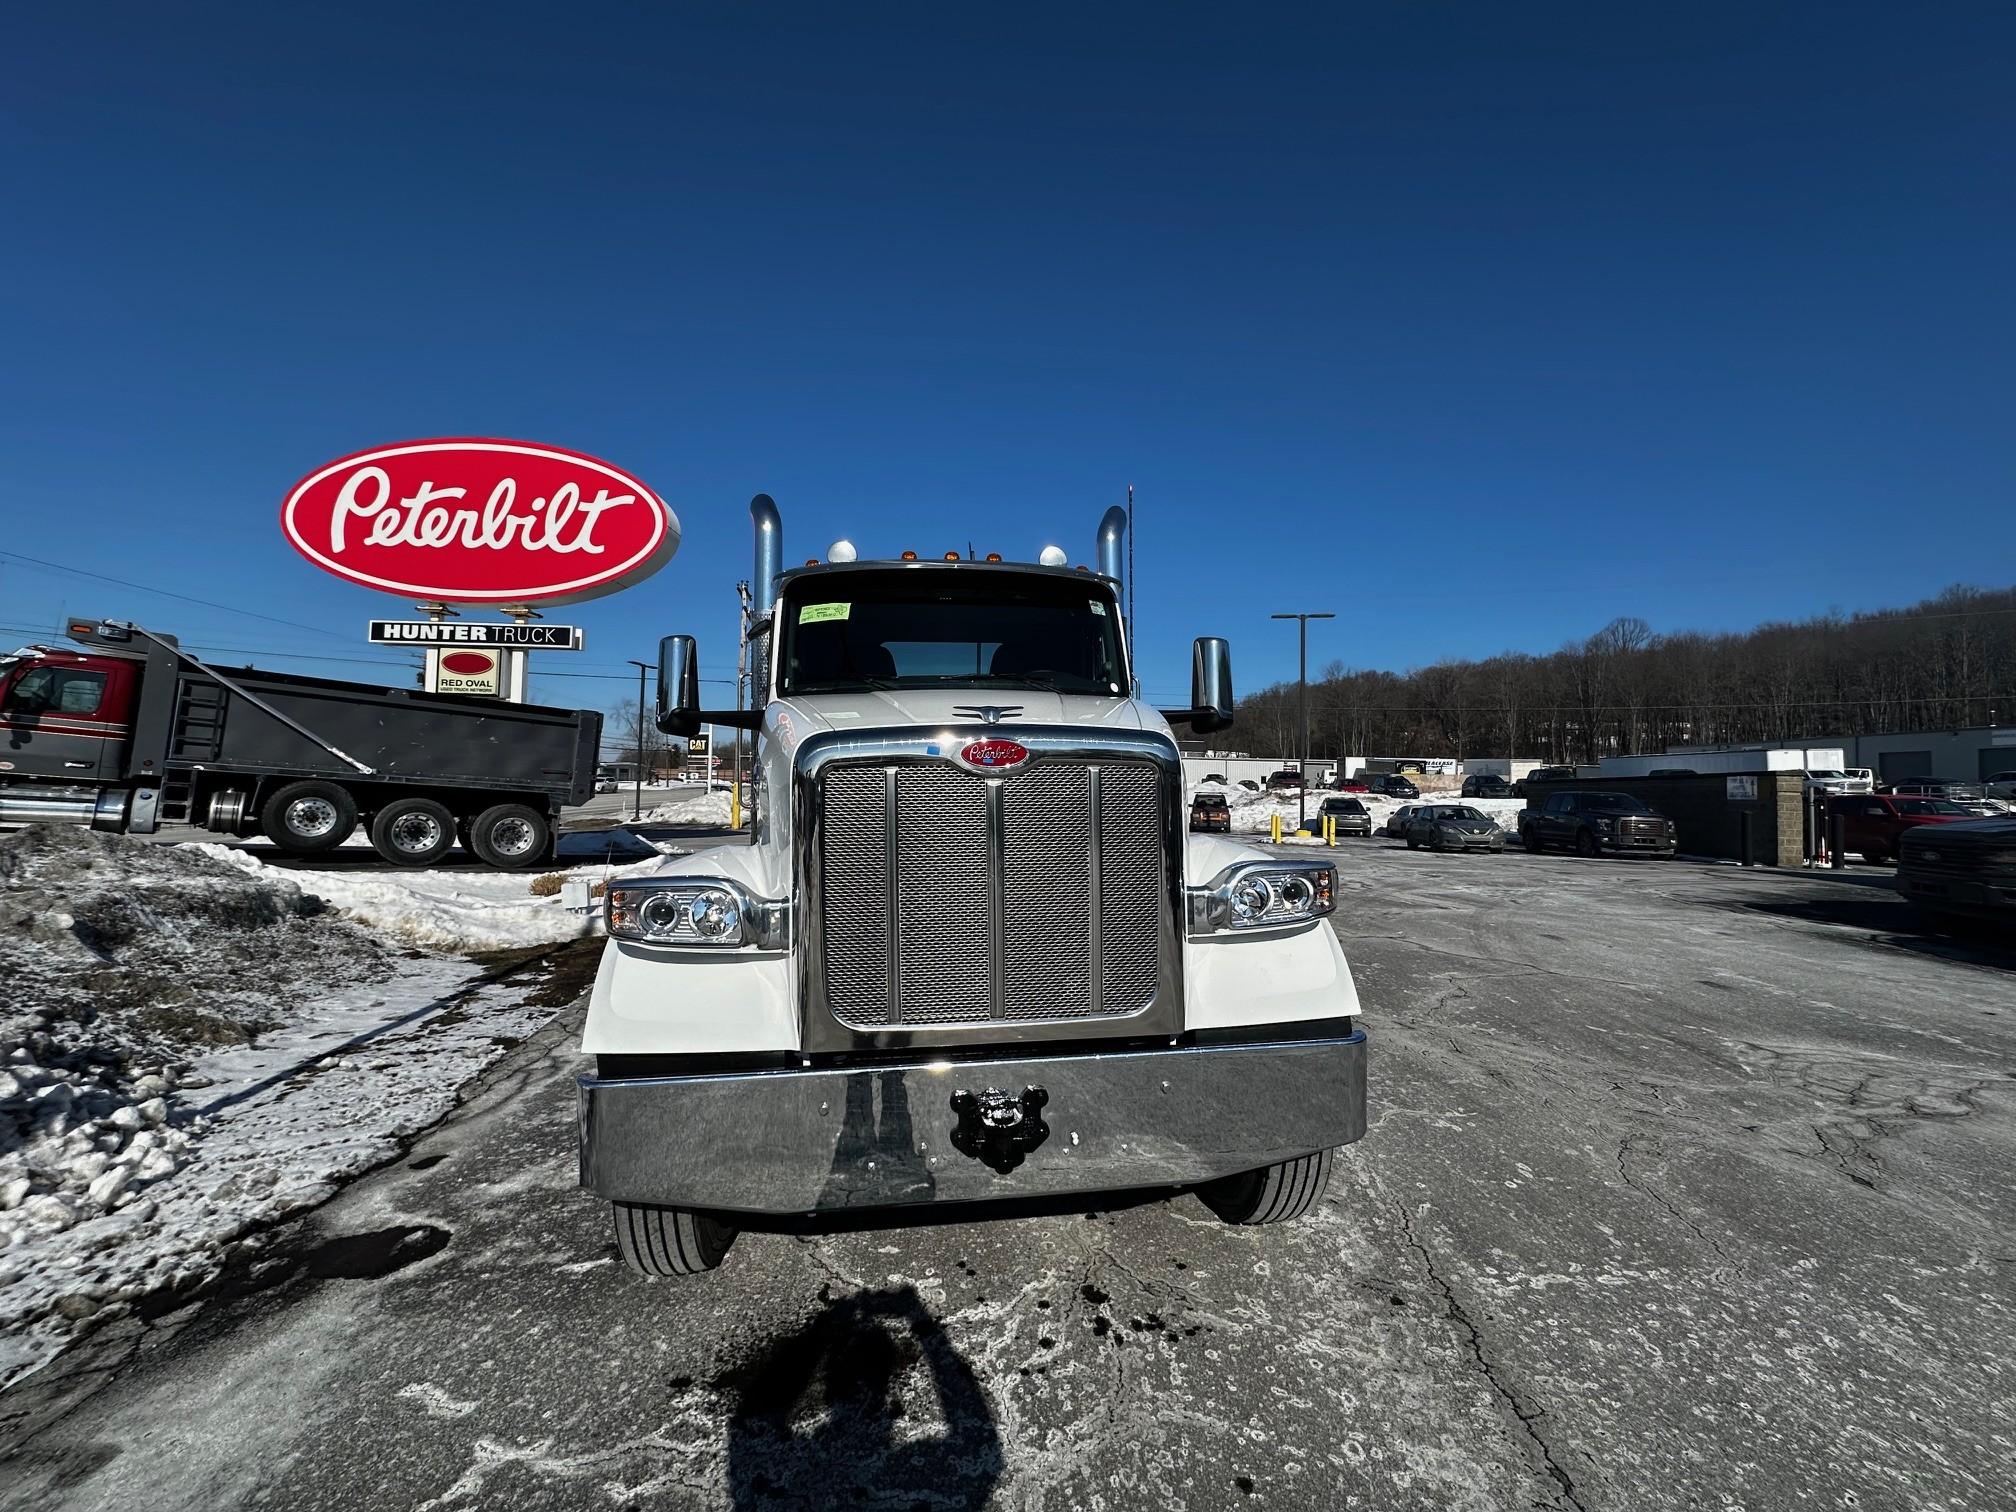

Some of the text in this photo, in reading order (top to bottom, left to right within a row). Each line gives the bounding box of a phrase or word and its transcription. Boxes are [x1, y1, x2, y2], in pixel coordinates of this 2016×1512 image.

[331, 466, 635, 553] Peterbilt
[383, 624, 556, 643] HUNTER TRUCK
[441, 679, 493, 688] RED OVAL
[690, 740, 706, 750] CAT
[969, 745, 1021, 760] Peterbilt
